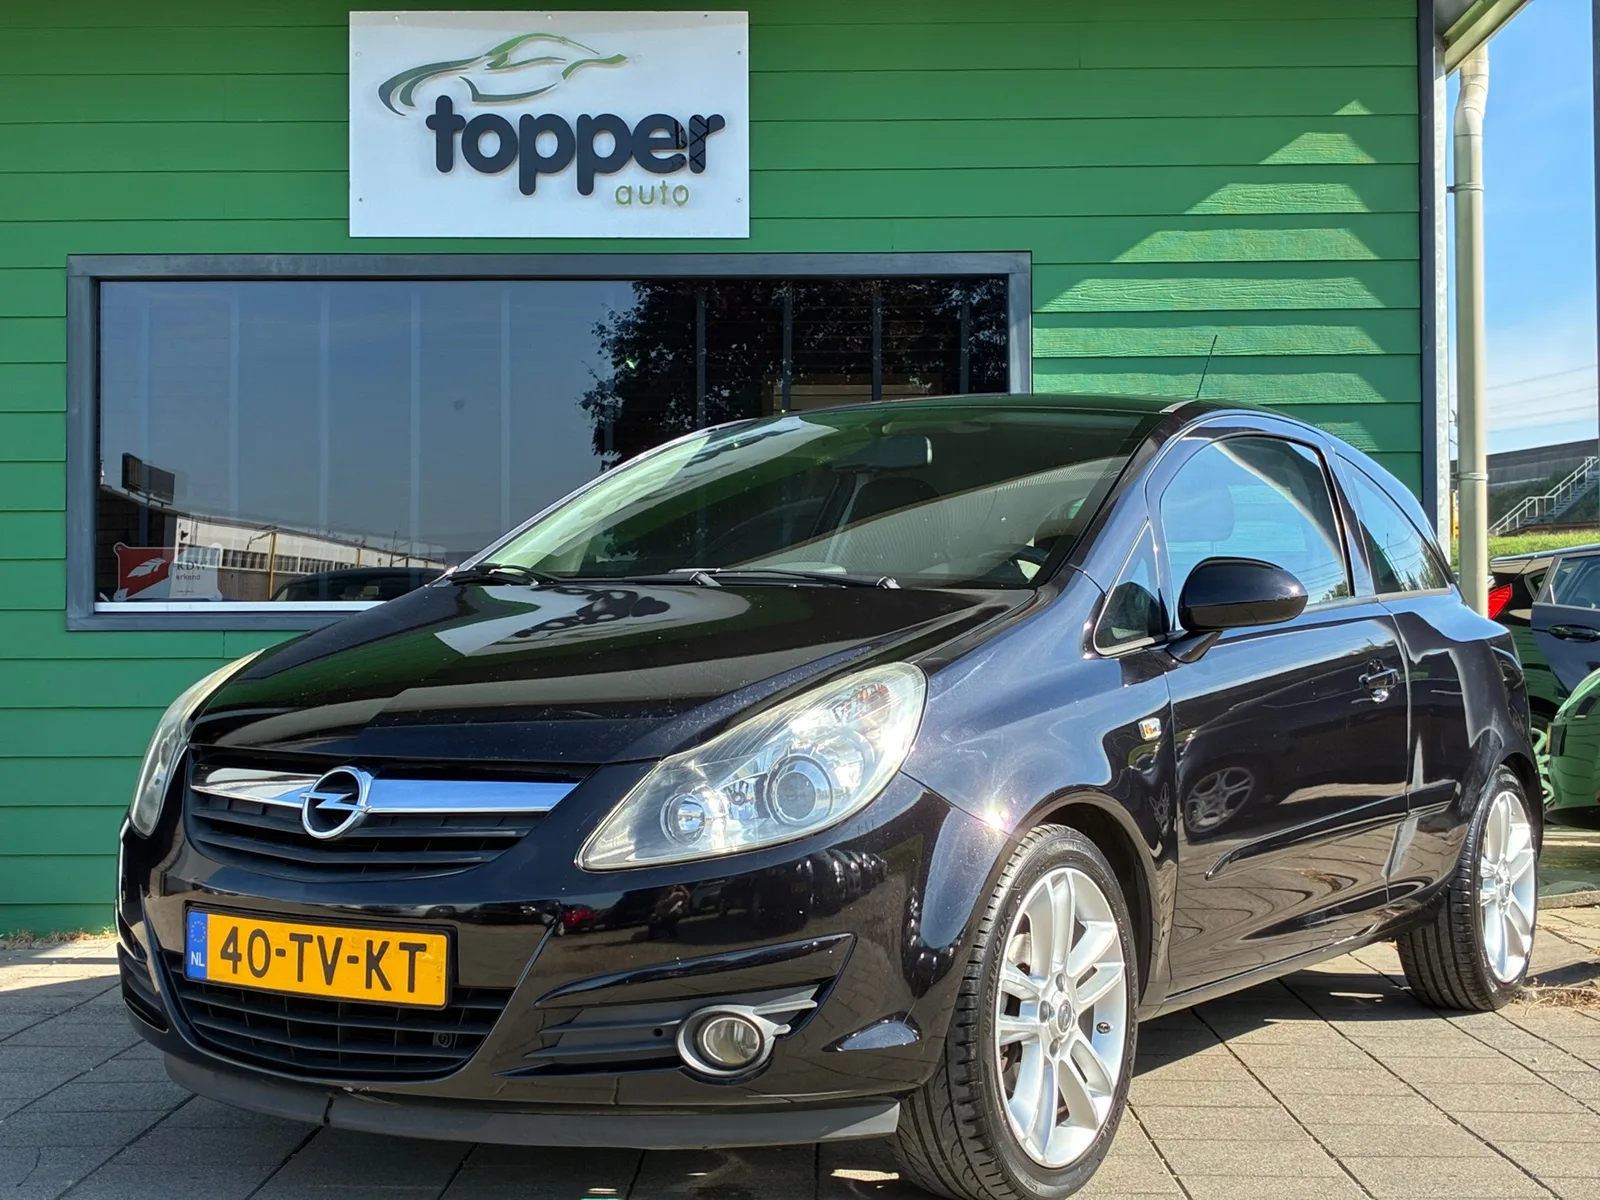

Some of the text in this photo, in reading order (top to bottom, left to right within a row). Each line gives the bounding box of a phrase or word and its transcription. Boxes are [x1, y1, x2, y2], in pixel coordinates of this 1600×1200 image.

[425, 95, 725, 196] topper
[614, 180, 689, 207] auto
[176, 560, 208, 570] RDW
[175, 573, 201, 581] erkend
[191, 951, 205, 967] NL
[220, 926, 427, 993] 40-TV-KT
